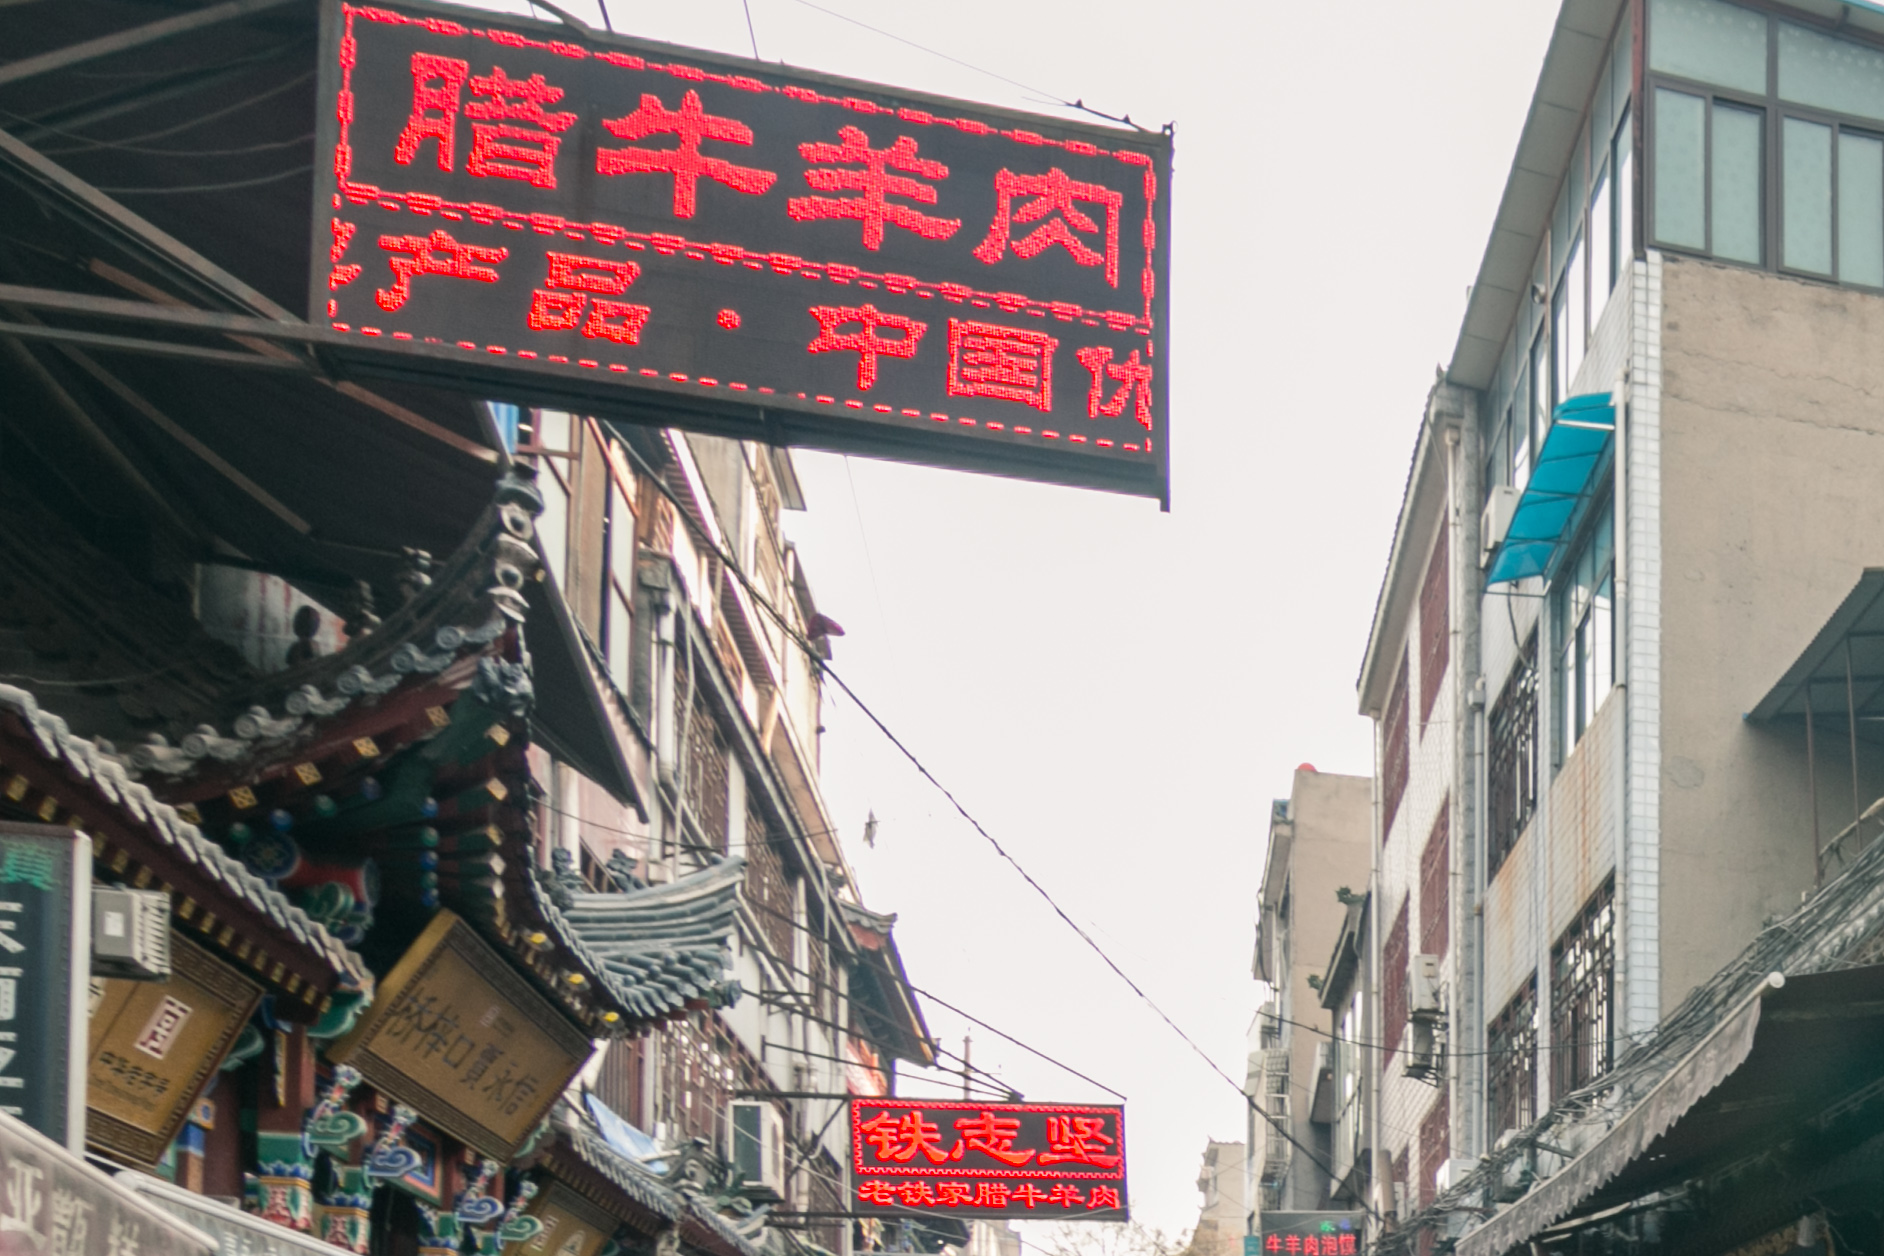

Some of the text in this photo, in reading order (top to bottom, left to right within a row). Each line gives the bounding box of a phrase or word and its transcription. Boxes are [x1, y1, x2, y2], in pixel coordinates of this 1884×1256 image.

[395, 52, 1123, 288] 腊牛羊肉
[860, 1110, 1116, 1169] 铁志坚
[858, 1181, 1121, 1210] 老铁家腊牛羊肉
[1265, 1233, 1356, 1256] 牛羊肉泡馍
